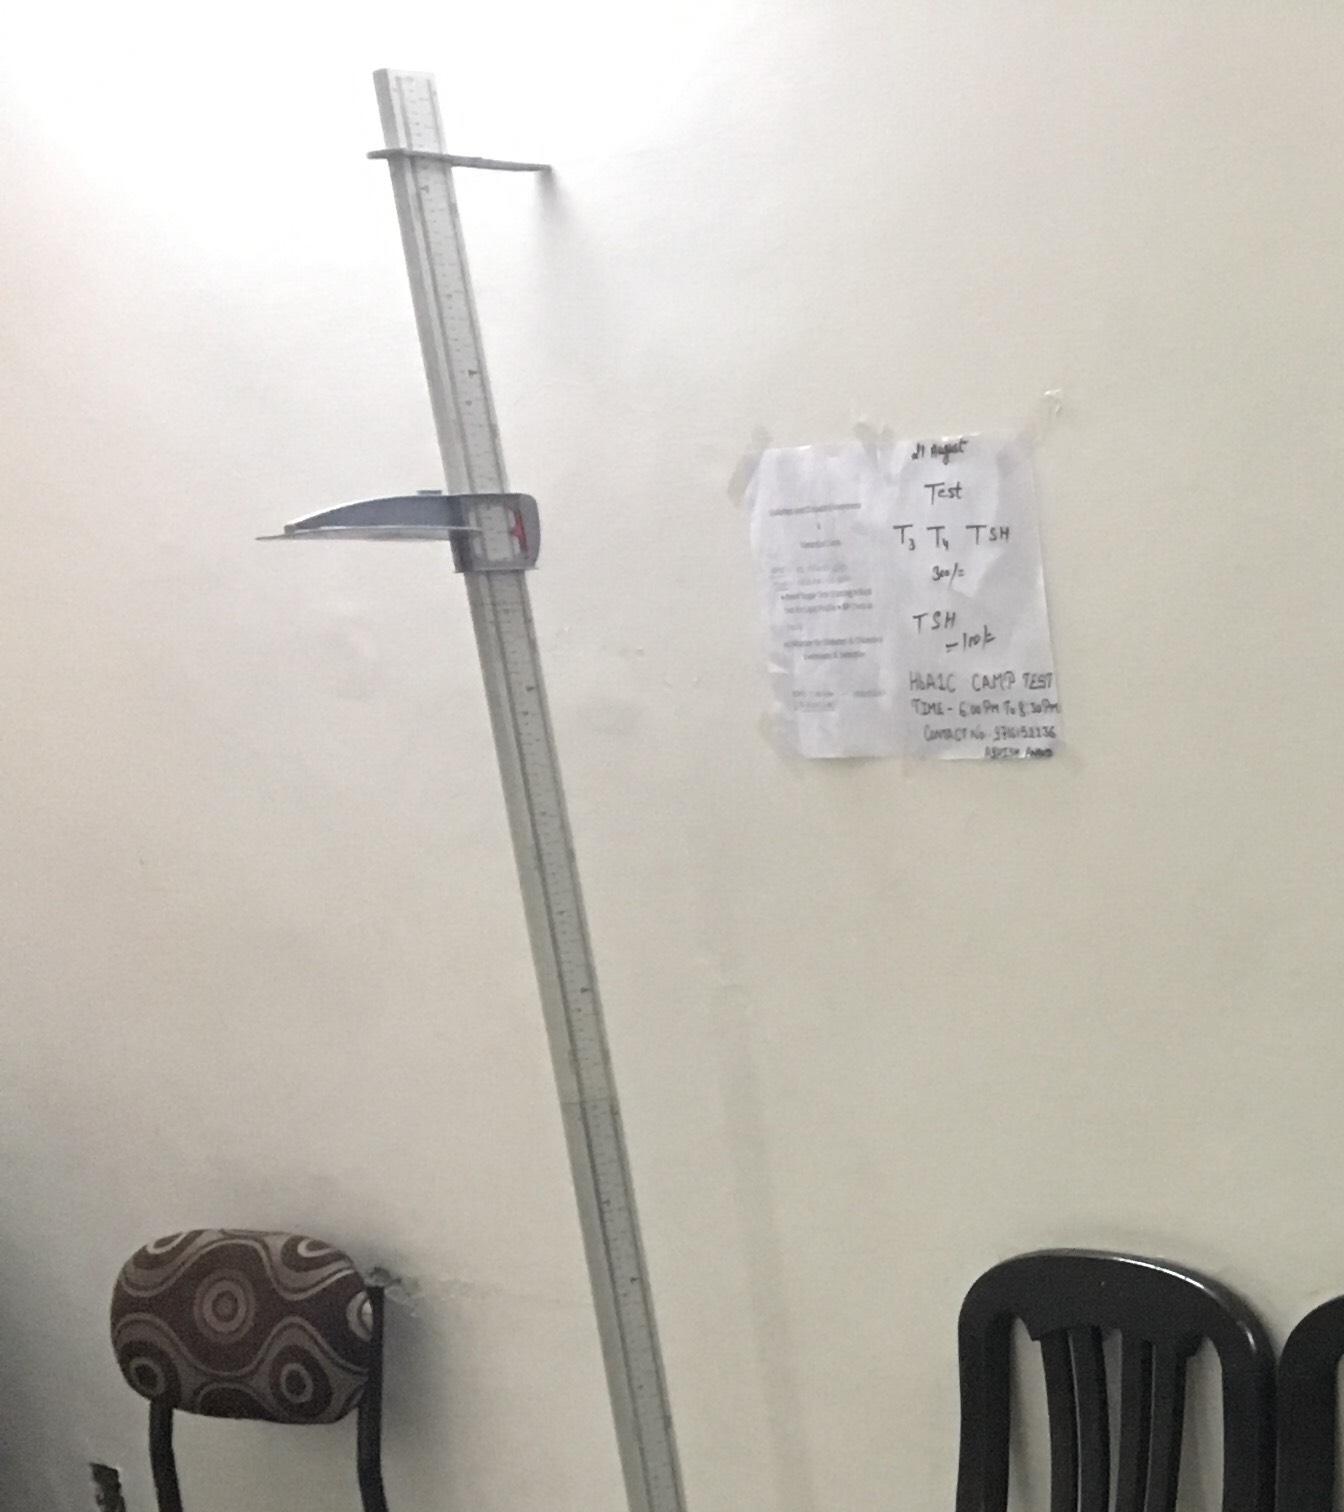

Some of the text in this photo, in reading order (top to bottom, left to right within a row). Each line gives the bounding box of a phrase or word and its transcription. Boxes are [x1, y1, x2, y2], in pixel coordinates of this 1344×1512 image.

[924, 481, 962, 505] Test
[972, 670, 1015, 691] CAMP
[1023, 672, 1053, 690] TEST
